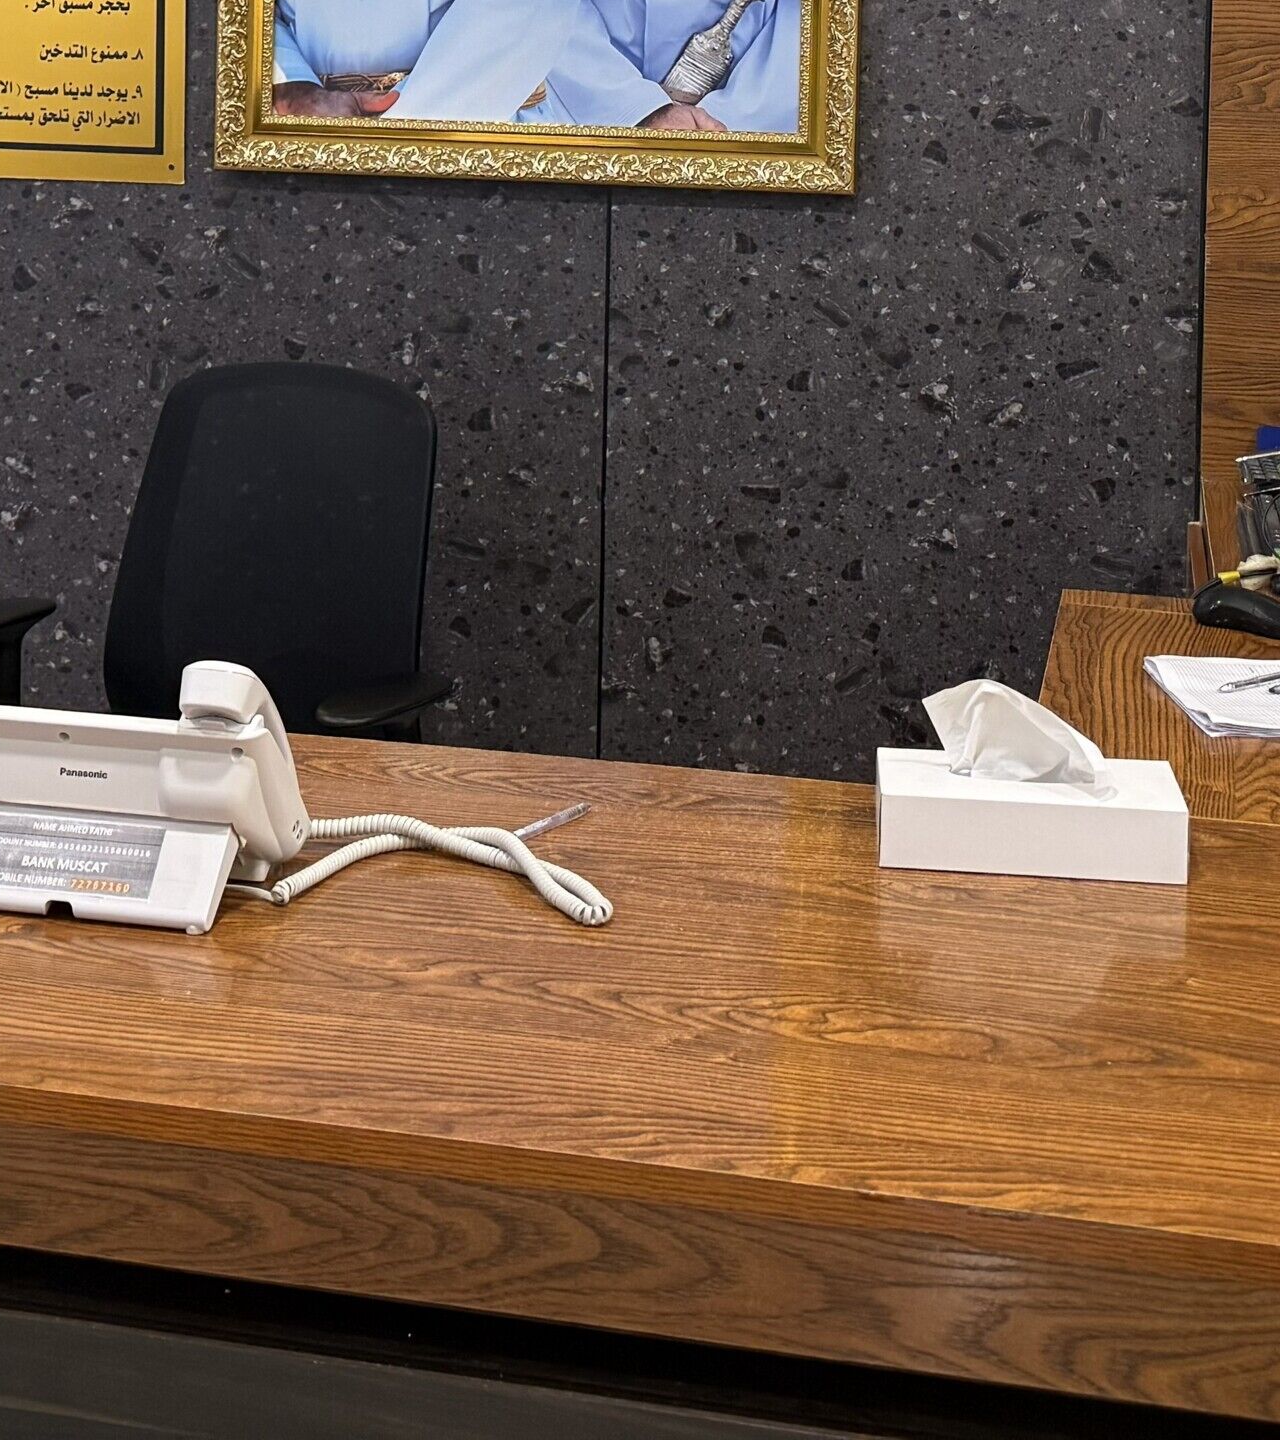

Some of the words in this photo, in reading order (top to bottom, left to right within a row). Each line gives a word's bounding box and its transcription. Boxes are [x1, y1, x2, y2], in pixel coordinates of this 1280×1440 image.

[39, 43, 88, 63] التدخين
[90, 45, 129, 64] ممنوع
[59, 766, 108, 779] Panasonic
[21, 854, 55, 870] BANK
[56, 857, 108, 874] MUSCAT
[24, 874, 67, 888] NUMBER:
